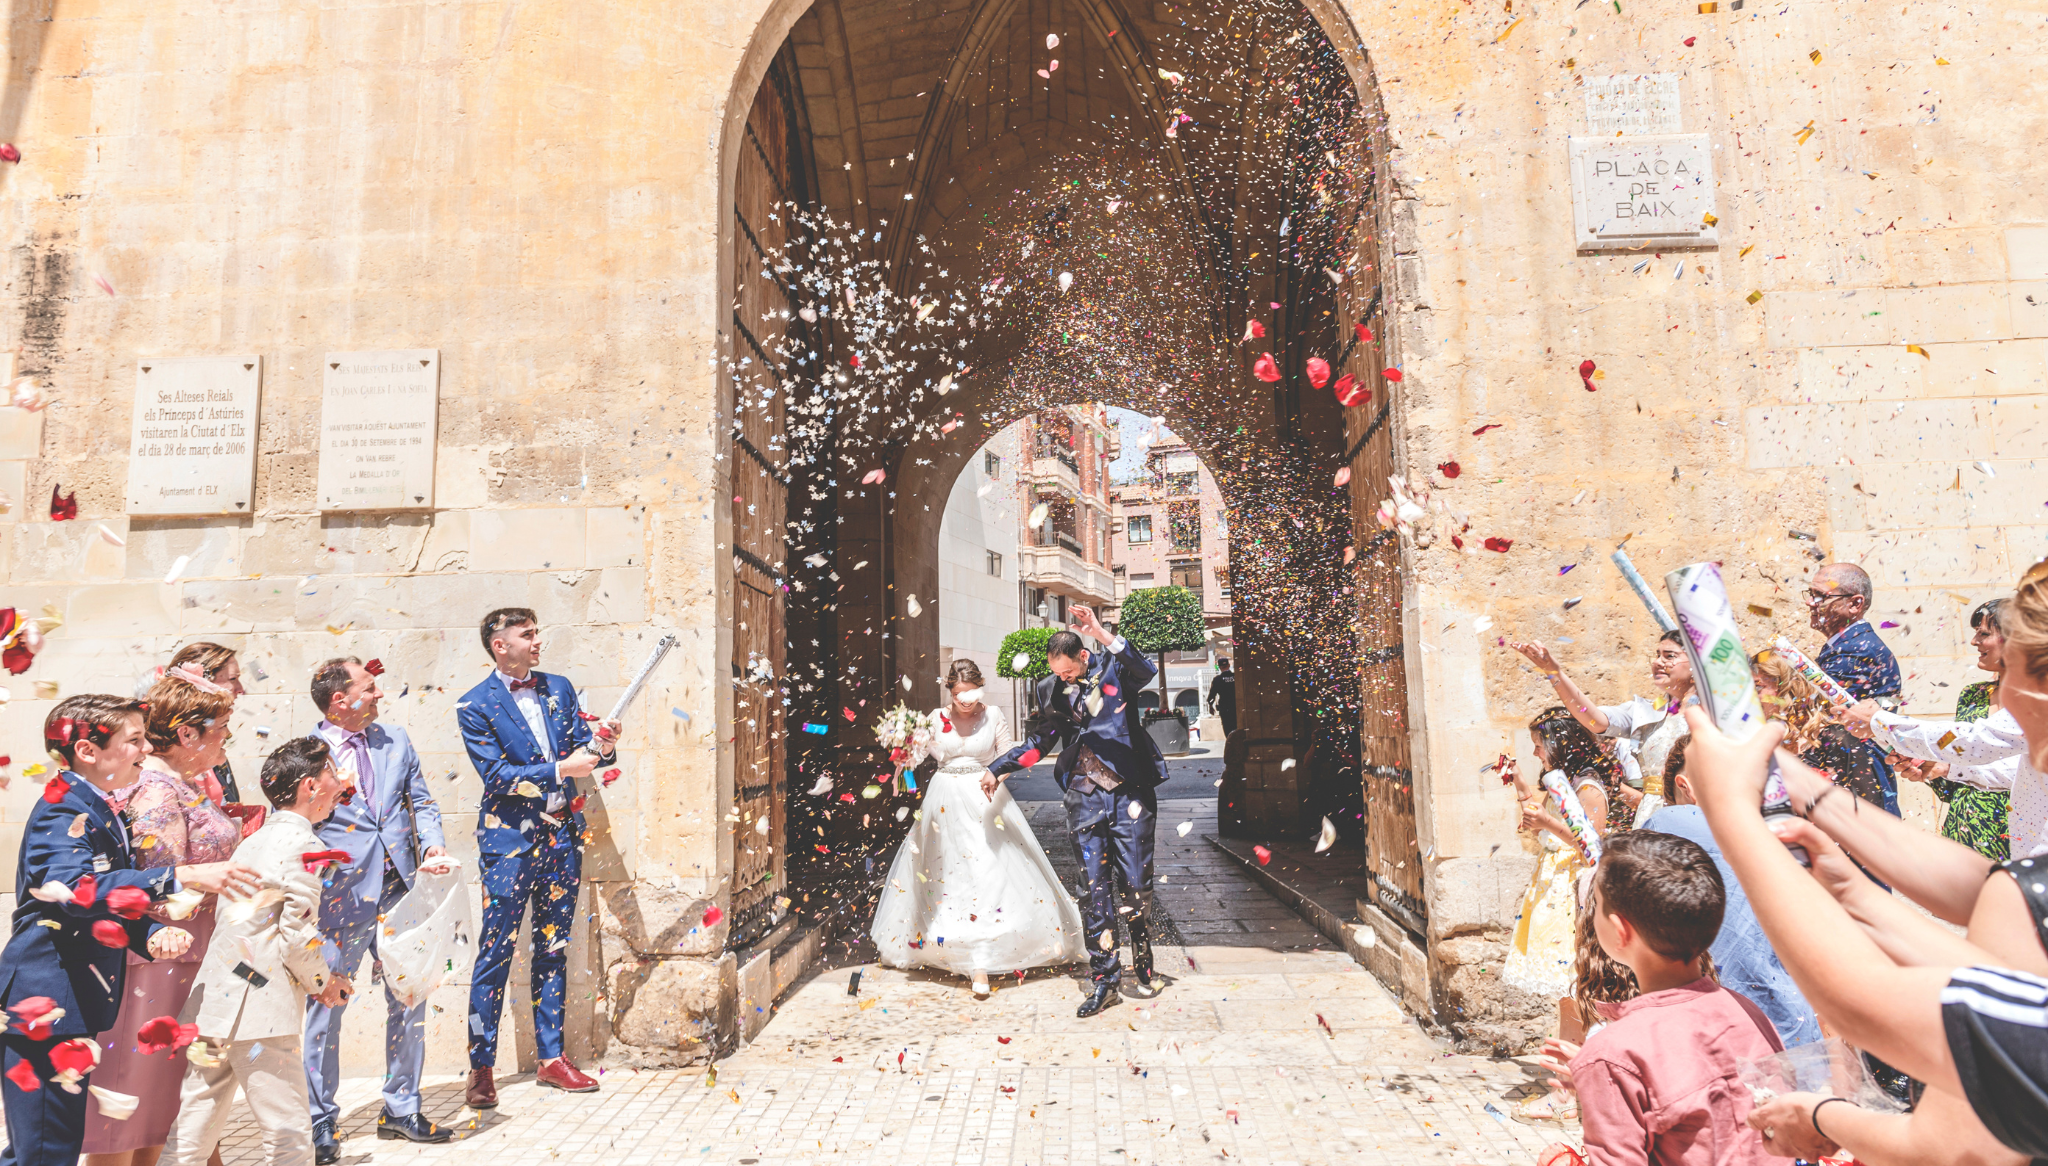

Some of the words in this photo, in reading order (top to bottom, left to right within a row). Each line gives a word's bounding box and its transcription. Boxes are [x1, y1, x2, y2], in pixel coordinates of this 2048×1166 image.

[1630, 182, 1660, 196] DE
[1616, 200, 1677, 218] BAIX
[157, 390, 172, 404] Ses
[174, 389, 205, 403] Alteses
[206, 388, 234, 402] Reials
[360, 385, 386, 396] CARLES
[144, 408, 156, 422] els
[158, 408, 196, 424] Prínceps
[140, 427, 178, 439] visitaren
[180, 425, 188, 438] la
[190, 424, 218, 438] Ciutat
[342, 424, 363, 432] VISITAR
[364, 422, 387, 431] AQUEST
[388, 422, 426, 430] AJUNTAMENT
[332, 440, 338, 448] EL
[340, 440, 349, 448] DIA
[360, 439, 367, 447] DE
[370, 438, 397, 446] SETEMBRE
[400, 438, 406, 446] DE
[409, 437, 422, 445] 1994
[138, 444, 147, 456] el
[148, 444, 162, 456] dia
[164, 444, 174, 456] 28
[176, 443, 187, 456] de
[189, 446, 210, 458] març
[212, 442, 224, 455] de
[226, 442, 246, 455] 2006
[356, 455, 364, 463] ON
[378, 454, 396, 462] REBRE
[349, 471, 356, 479] LA
[358, 470, 384, 478] MEDALLA
[159, 486, 196, 498] Ajuntament
[1710, 638, 1734, 664] 100
[1166, 674, 1192, 682] Innova
